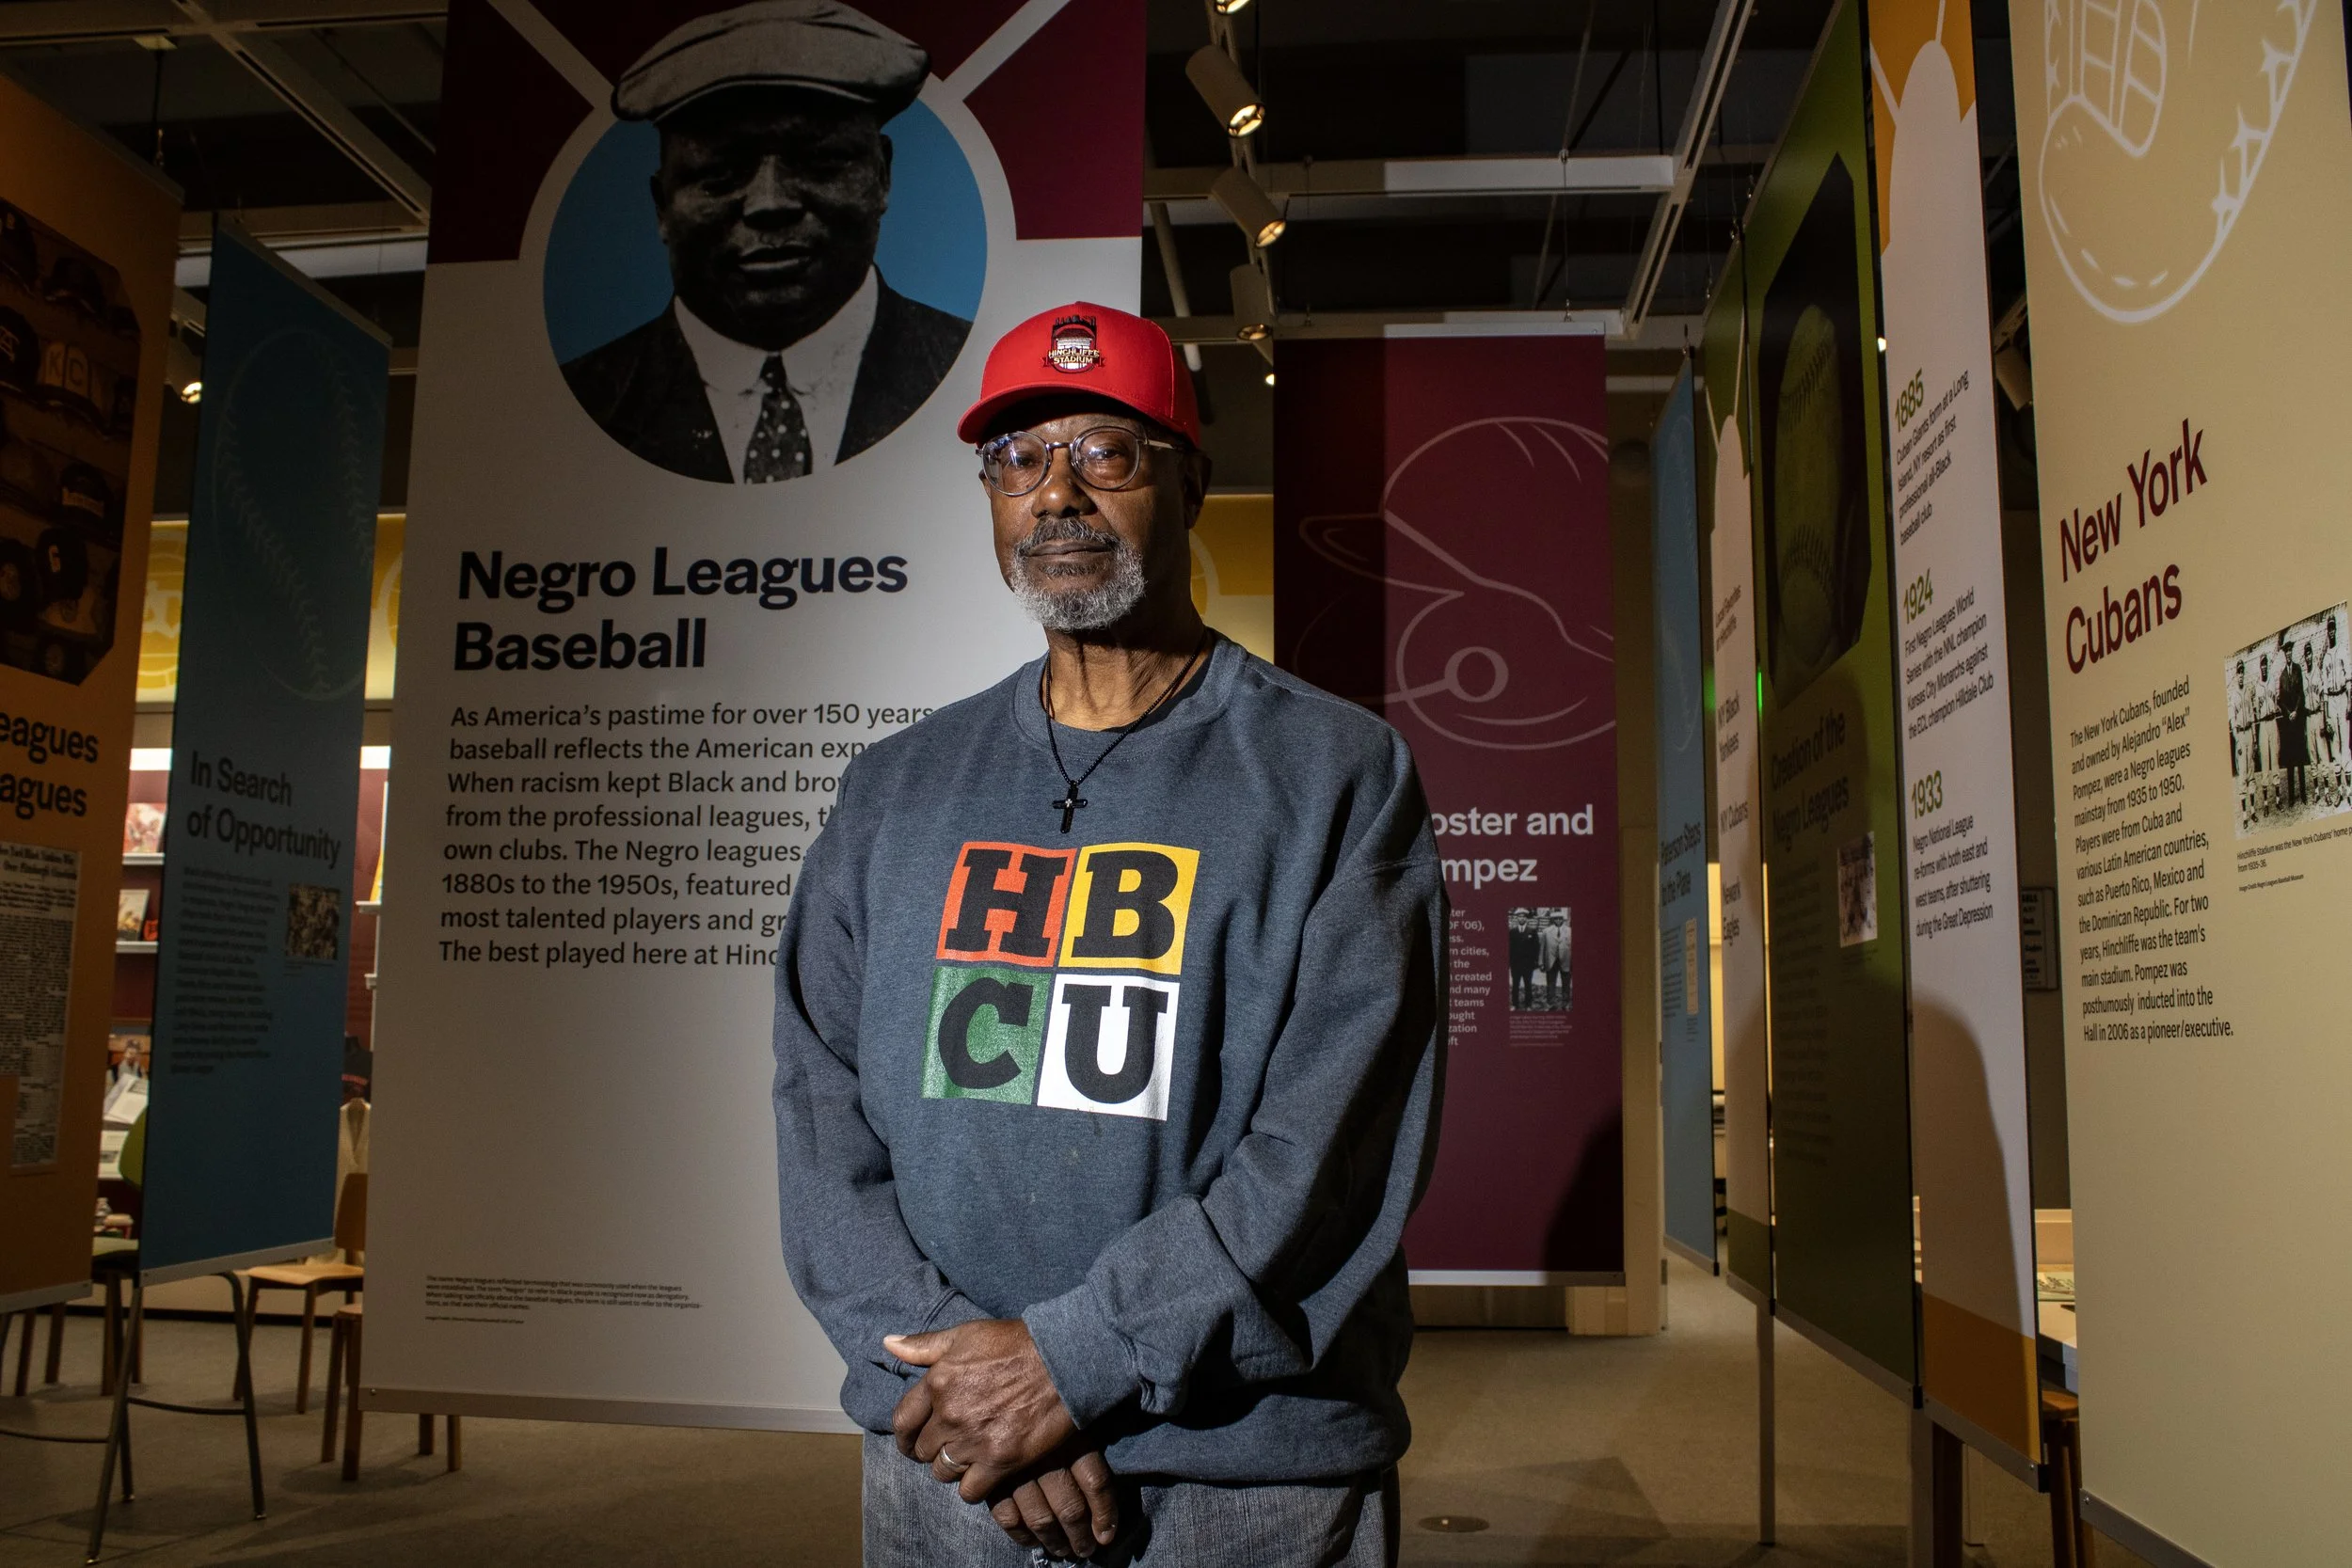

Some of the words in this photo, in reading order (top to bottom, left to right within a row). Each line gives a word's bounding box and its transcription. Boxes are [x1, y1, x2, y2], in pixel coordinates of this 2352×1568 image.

[1896, 368, 1924, 432] 1885
[2060, 493, 2122, 582] New
[2127, 419, 2207, 528] York
[458, 551, 635, 613] Negro
[654, 547, 908, 611] Leagues
[1903, 567, 1932, 624] 1924
[1905, 639, 1915, 657] First
[1916, 627, 1932, 648] Negro
[1932, 605, 1955, 637] Leagues
[1956, 587, 1974, 616] World
[2066, 564, 2182, 673] Cubans
[453, 617, 707, 671] Baseball
[451, 706, 478, 727] As
[608, 704, 705, 731] pastime
[711, 702, 747, 724] for
[753, 708, 807, 724] over
[814, 704, 860, 724] 150
[2071, 730, 2083, 747] The
[2084, 724, 2100, 741] New
[2101, 711, 2118, 733] York
[2120, 700, 2151, 724] Cubans,
[2153, 674, 2189, 709] founded
[0, 712, 99, 764] eagues
[450, 737, 547, 760] baseball
[554, 736, 643, 759] reflects
[649, 736, 690, 759] the
[695, 737, 813, 758] American
[821, 742, 873, 759] exp
[1771, 736, 1812, 791] Creation
[1813, 715, 1824, 761] of
[1825, 708, 1846, 749] the
[2072, 753, 2084, 774] and
[2086, 742, 2109, 768] owned
[2111, 740, 2120, 760] by
[2122, 723, 2160, 752] Alejandro
[191, 750, 212, 788] In
[217, 757, 292, 806] Search
[448, 771, 514, 793] When
[521, 771, 599, 793] racism
[608, 770, 660, 799] kept
[669, 770, 734, 792] Black
[740, 770, 787, 792] and
[795, 770, 840, 792] bro
[2074, 779, 2103, 800] Pompez,
[2104, 770, 2122, 788] were
[2124, 768, 2129, 781] a
[2130, 757, 2154, 780] Negro
[2156, 743, 2190, 769] leagues
[0, 773, 87, 820] agues
[1772, 804, 1800, 854] Negro
[1803, 775, 1849, 833] Leagues
[1912, 769, 1942, 819] 1933
[2074, 805, 2106, 827] mainstay
[2107, 798, 2125, 815] from
[2127, 786, 2147, 808] 1935
[2149, 785, 2157, 800] to
[2159, 773, 2185, 797] 1950.
[187, 804, 213, 838] of
[216, 808, 341, 870] Opportunity
[446, 804, 501, 827] from
[508, 804, 547, 827] the
[553, 804, 701, 832] professional
[709, 804, 809, 833] leagues,
[1432, 806, 1518, 836] oster
[1526, 803, 1594, 836] and
[1913, 835, 1928, 855] Negro
[1929, 819, 1951, 845] National
[1952, 815, 1973, 837] League
[2075, 835, 2101, 855] Players
[2102, 829, 2120, 845] were
[2122, 821, 2140, 839] from
[2142, 811, 2164, 832] Cuba
[2166, 803, 2182, 826] and
[443, 844, 492, 861] own
[499, 838, 567, 861] clubs.
[575, 838, 618, 861] The
[626, 840, 699, 867] Negro
[1443, 858, 1538, 890] mpez
[2077, 862, 2102, 879] various
[2104, 856, 2122, 873] Latin
[2124, 845, 2162, 866] American
[2164, 830, 2209, 856] countries,
[442, 873, 515, 895] 1880s
[521, 875, 546, 895] to
[552, 872, 591, 895] the
[597, 874, 678, 900] 1950s,
[686, 873, 790, 895] featured
[2078, 888, 2094, 907] such
[2096, 889, 2104, 903] as
[2106, 881, 2130, 900] Puerto
[2132, 876, 2152, 895] Rico,
[2153, 867, 2185, 889] Mexico
[2186, 859, 2204, 881] and
[441, 908, 500, 928] most
[505, 906, 605, 929] talented
[613, 907, 700, 935] players
[707, 908, 753, 930] and
[1724, 918, 1740, 946] Eagles
[2079, 916, 2090, 933] the
[2092, 911, 2132, 931] Dominican
[2134, 899, 2172, 926] Republic.
[2174, 897, 2189, 915] For
[2190, 895, 2208, 912] two
[438, 939, 482, 962] The
[488, 940, 539, 963] best
[546, 941, 625, 969] played
[633, 942, 687, 964] here
[694, 944, 718, 965] at
[726, 943, 778, 966] Hinc
[1454, 959, 1470, 968] the
[1461, 946, 1489, 957] cities,
[2080, 945, 2101, 964] years,
[2103, 933, 2139, 957] Hinchliffe
[2140, 936, 2157, 951] was
[2158, 928, 2173, 948] the
[2174, 924, 2205, 946] team's
[1454, 972, 1492, 981] created
[1464, 986, 1490, 996] many
[2082, 974, 2099, 986] main
[2101, 966, 2133, 985] stadium.
[2135, 964, 2169, 984] Pompez
[2169, 961, 2187, 976] was
[2083, 993, 2134, 1019] posthumously
[2137, 989, 2175, 1009] inducted
[2177, 989, 2195, 1006] into
[2197, 986, 2213, 1006] the
[2084, 1023, 2097, 1041] Hall
[2099, 1025, 2106, 1040] in
[2107, 1023, 2128, 1040] 2006
[2130, 1026, 2139, 1039] as
[2140, 1026, 2146, 1039] a
[2148, 1017, 2233, 1044] pioneer/executive.
